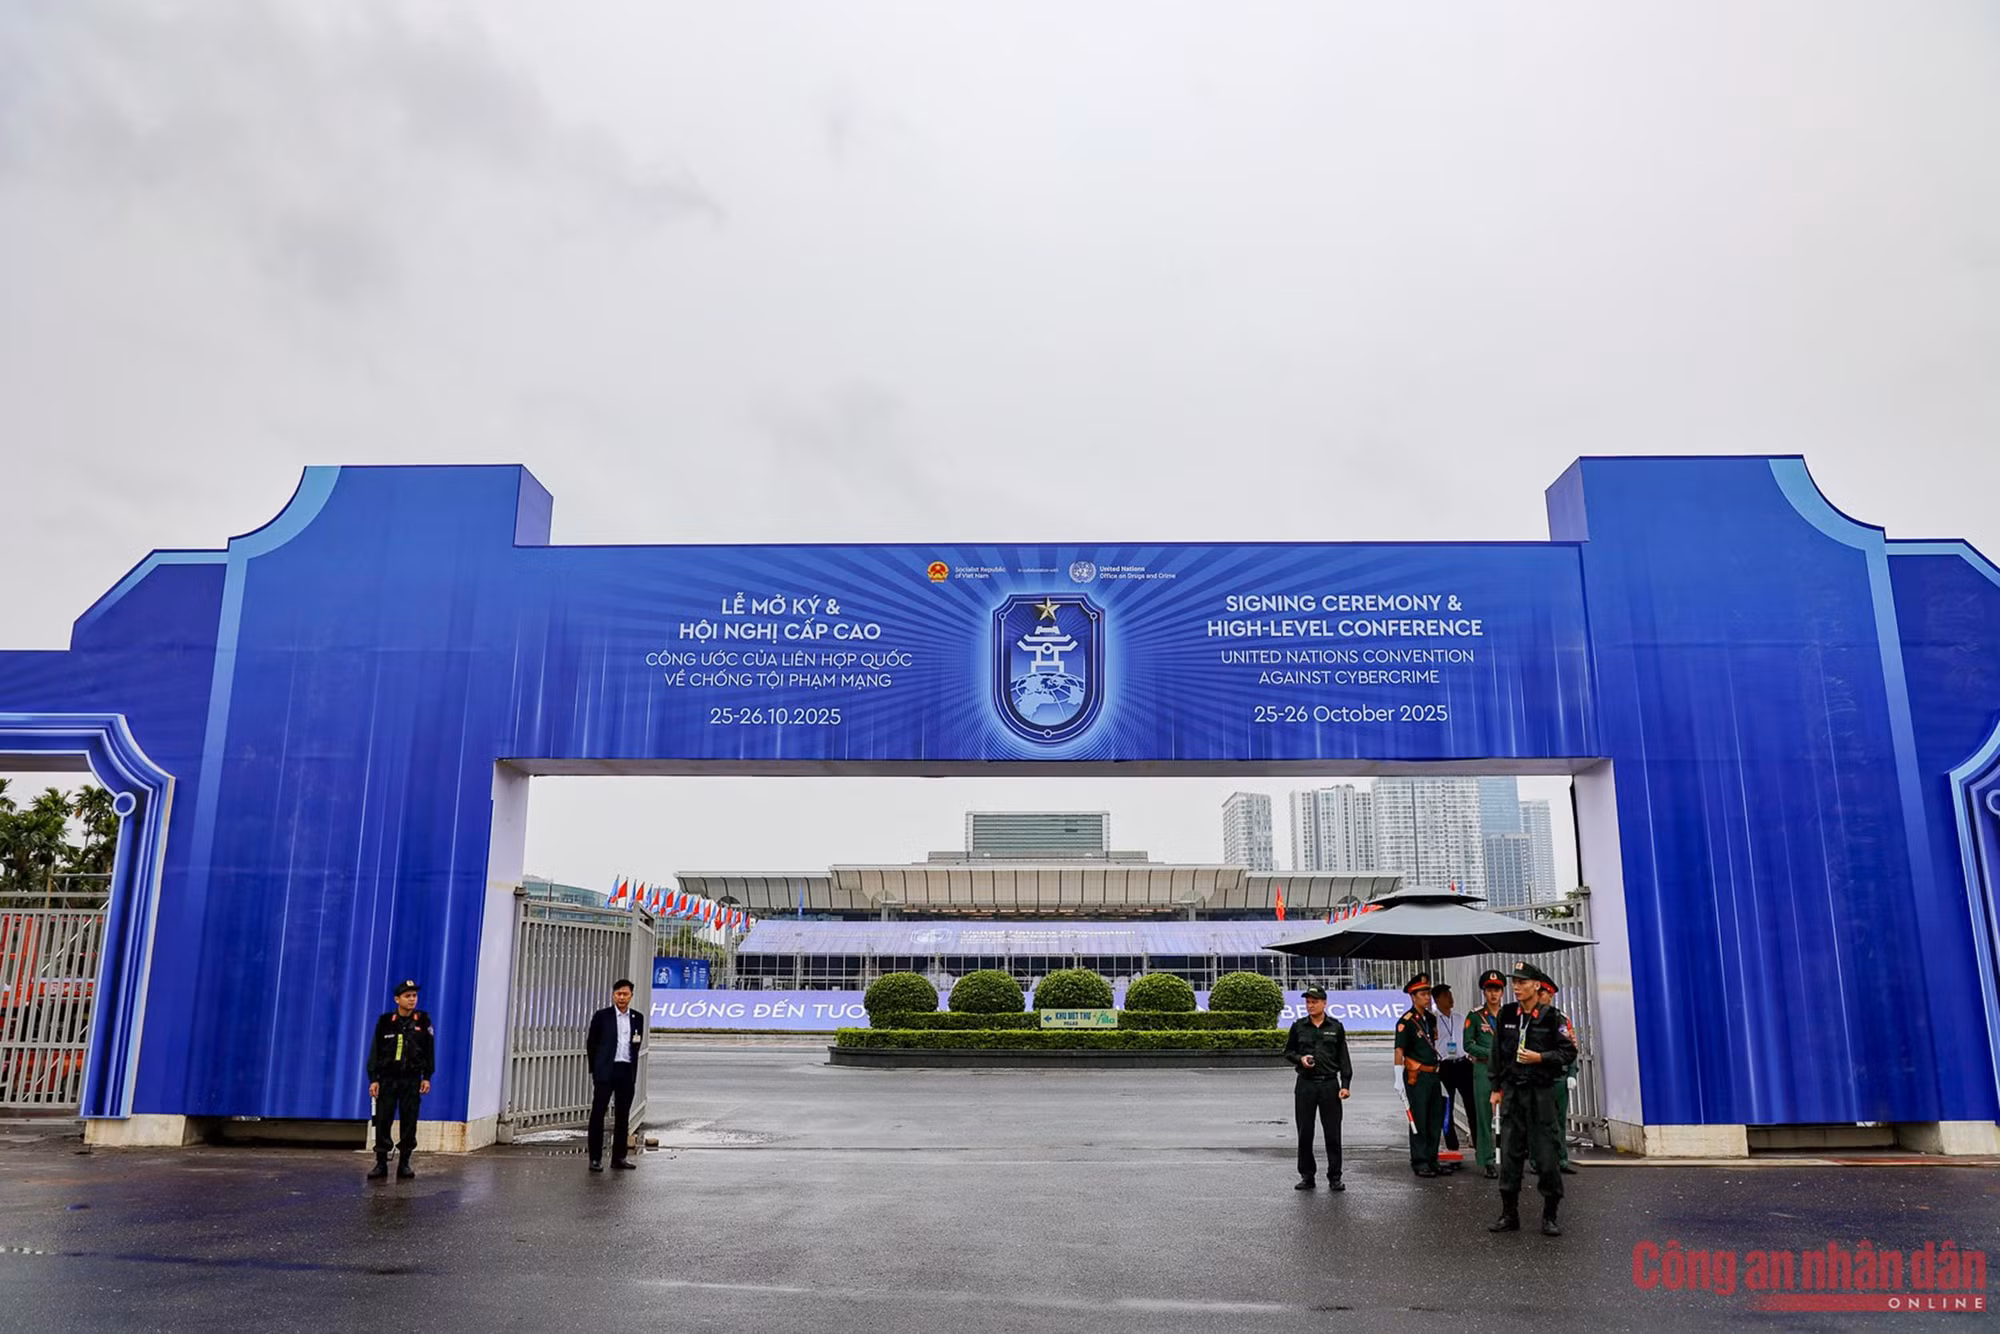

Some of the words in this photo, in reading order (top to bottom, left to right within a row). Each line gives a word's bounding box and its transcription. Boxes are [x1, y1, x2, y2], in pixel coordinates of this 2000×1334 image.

[1127, 572, 1145, 580] Drugs
[722, 592, 745, 615] LỄ
[751, 594, 786, 615] MỞ
[792, 594, 821, 615] KÝ
[825, 598, 841, 615] &
[1226, 595, 1316, 612] SIGNING
[1321, 595, 1441, 611] CEREMONY
[1447, 594, 1462, 611] &
[679, 619, 718, 644] HỘI
[724, 623, 778, 644] NGHỊ
[784, 617, 828, 640] CẤP
[833, 623, 881, 640] CAO
[1207, 620, 1334, 637] HIGH-LEVEL
[1338, 619, 1483, 637] CONFERENCE
[646, 650, 696, 666] CÔNG
[701, 650, 738, 666] ƯỚC
[742, 649, 778, 666] CỦA
[782, 650, 816, 666] LIÊN
[821, 652, 857, 669] HỢP
[860, 649, 912, 670] QUỐC
[1221, 650, 1282, 664] UNITED
[1286, 650, 1359, 664] NATIONS
[1363, 649, 1474, 663] CONVENTION
[664, 669, 685, 686] VỀ
[689, 669, 753, 687] CHỐNG
[756, 671, 784, 689] TỘI
[789, 673, 836, 689] PHẠM
[841, 673, 892, 690] MẠNG
[1259, 670, 1331, 685] AGAINST
[1335, 670, 1440, 684] CYBERCRIME
[710, 707, 841, 725] 25-26.10.2025
[1254, 705, 1308, 722] 25-26
[1313, 704, 1395, 722] October
[1400, 704, 1448, 722] 2025
[650, 1000, 745, 1018] HƯỚNG
[753, 999, 805, 1018] ĐẾN
